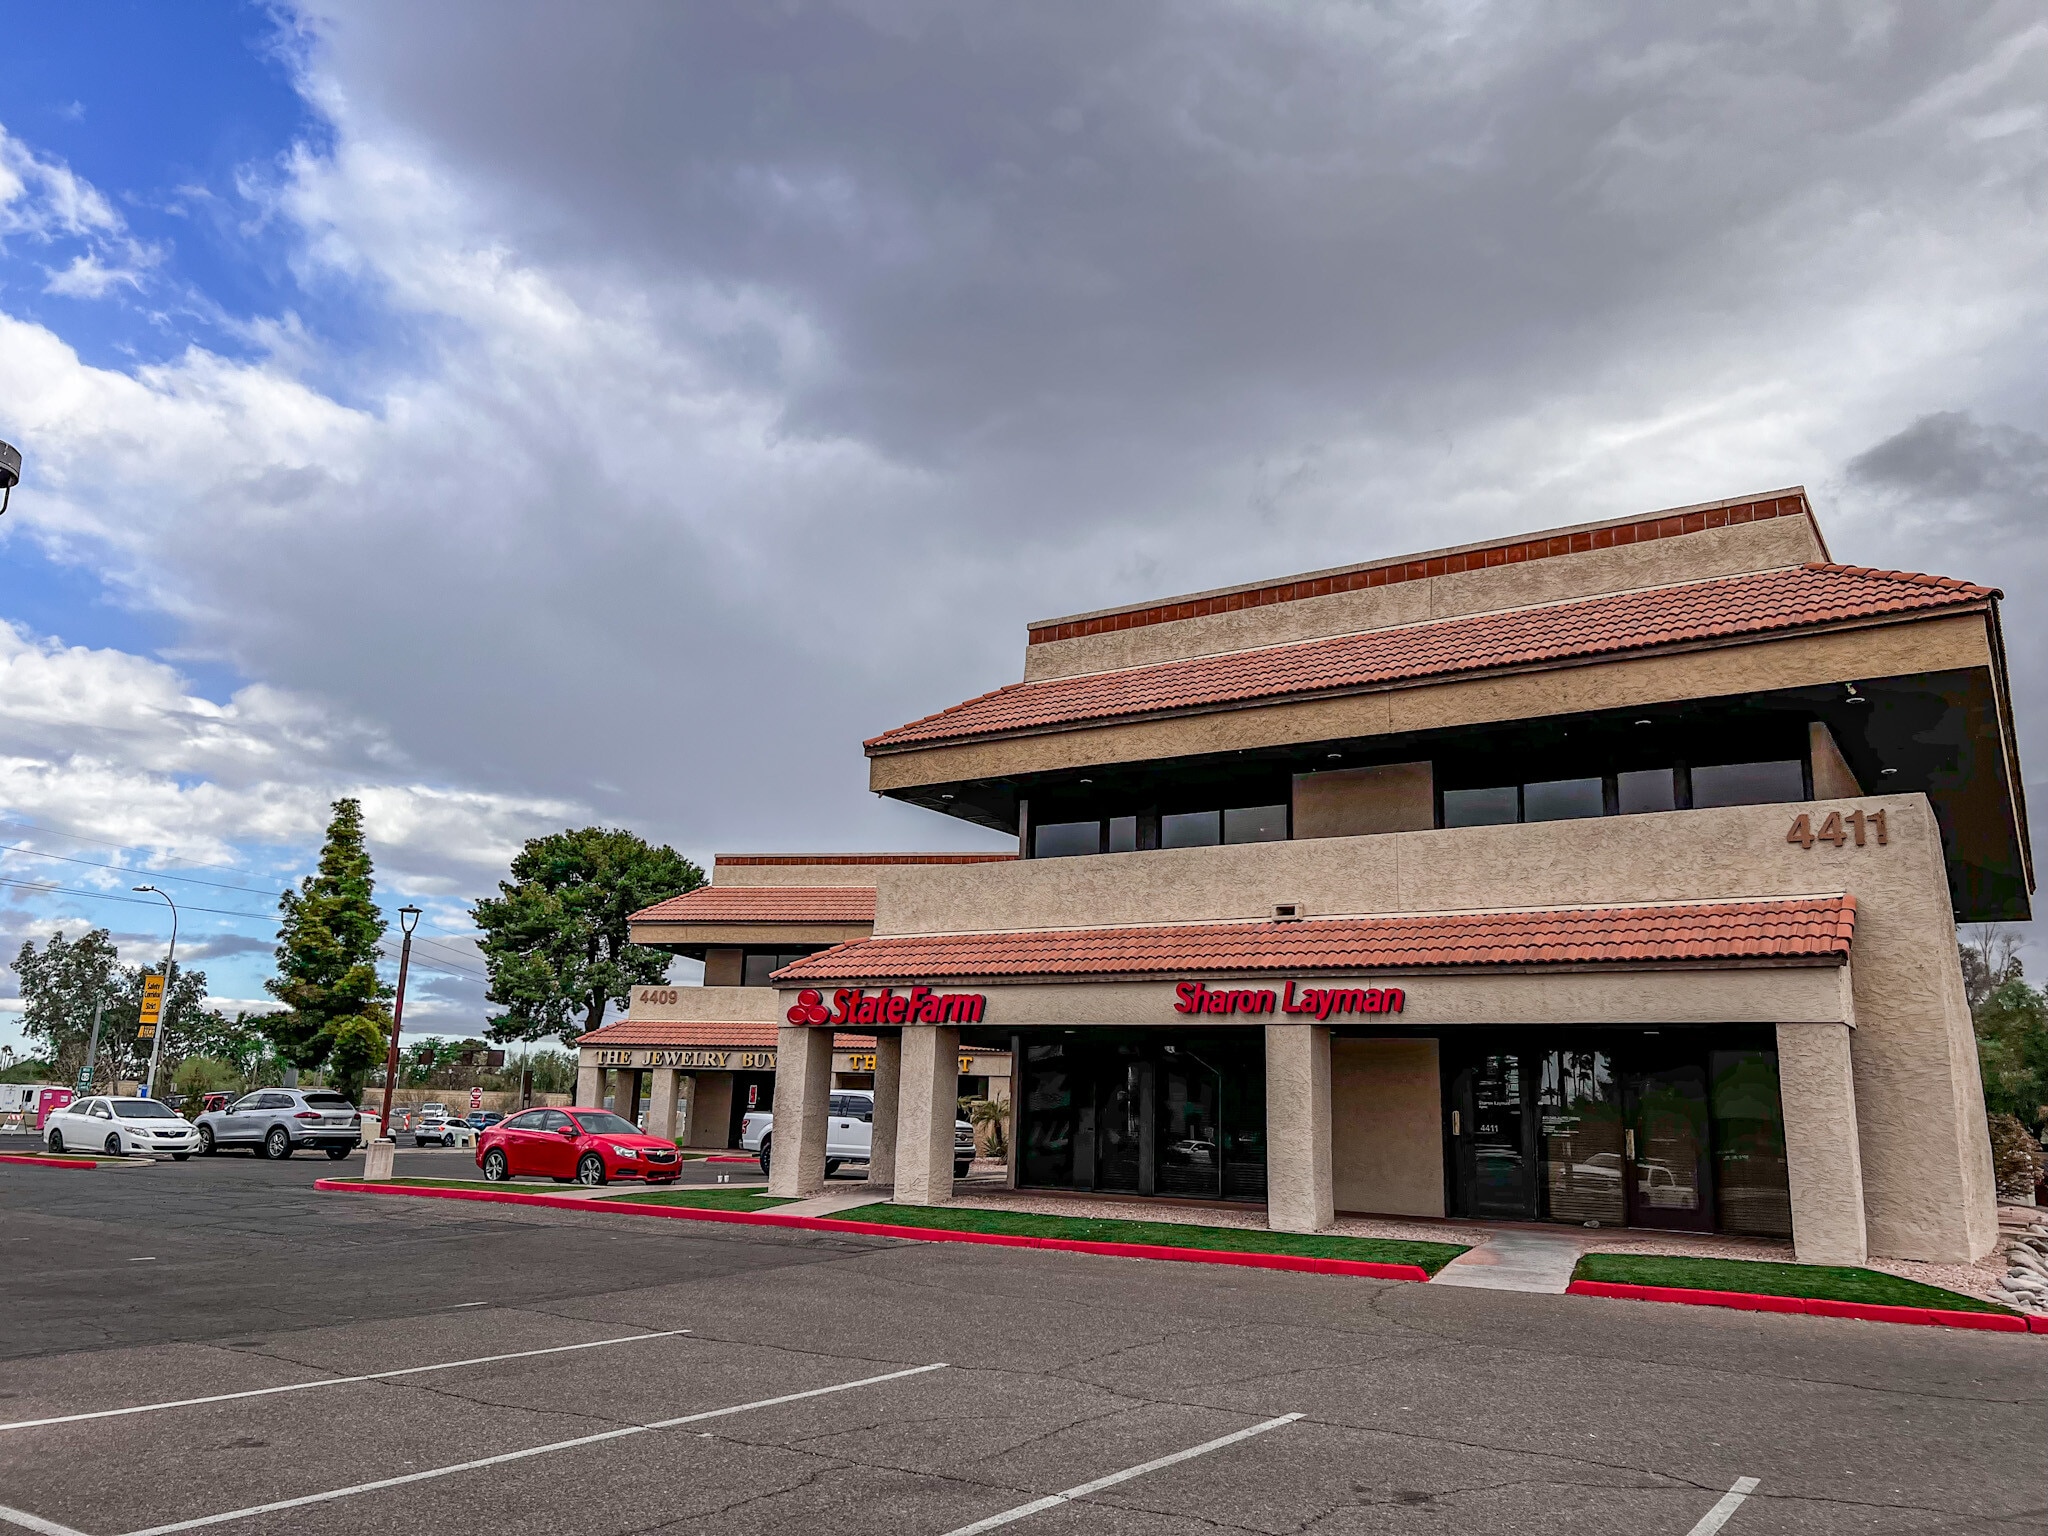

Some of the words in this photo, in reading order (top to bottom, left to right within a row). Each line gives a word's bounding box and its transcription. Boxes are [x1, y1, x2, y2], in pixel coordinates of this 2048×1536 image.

[1786, 808, 1888, 849] 4411
[639, 989, 678, 1005] 4409
[1173, 981, 1275, 1013] Sharon
[1281, 980, 1404, 1021] Layman
[595, 1050, 631, 1066] THE
[641, 1051, 731, 1067] JEWELRY
[1480, 1124, 1499, 1133] 4411
